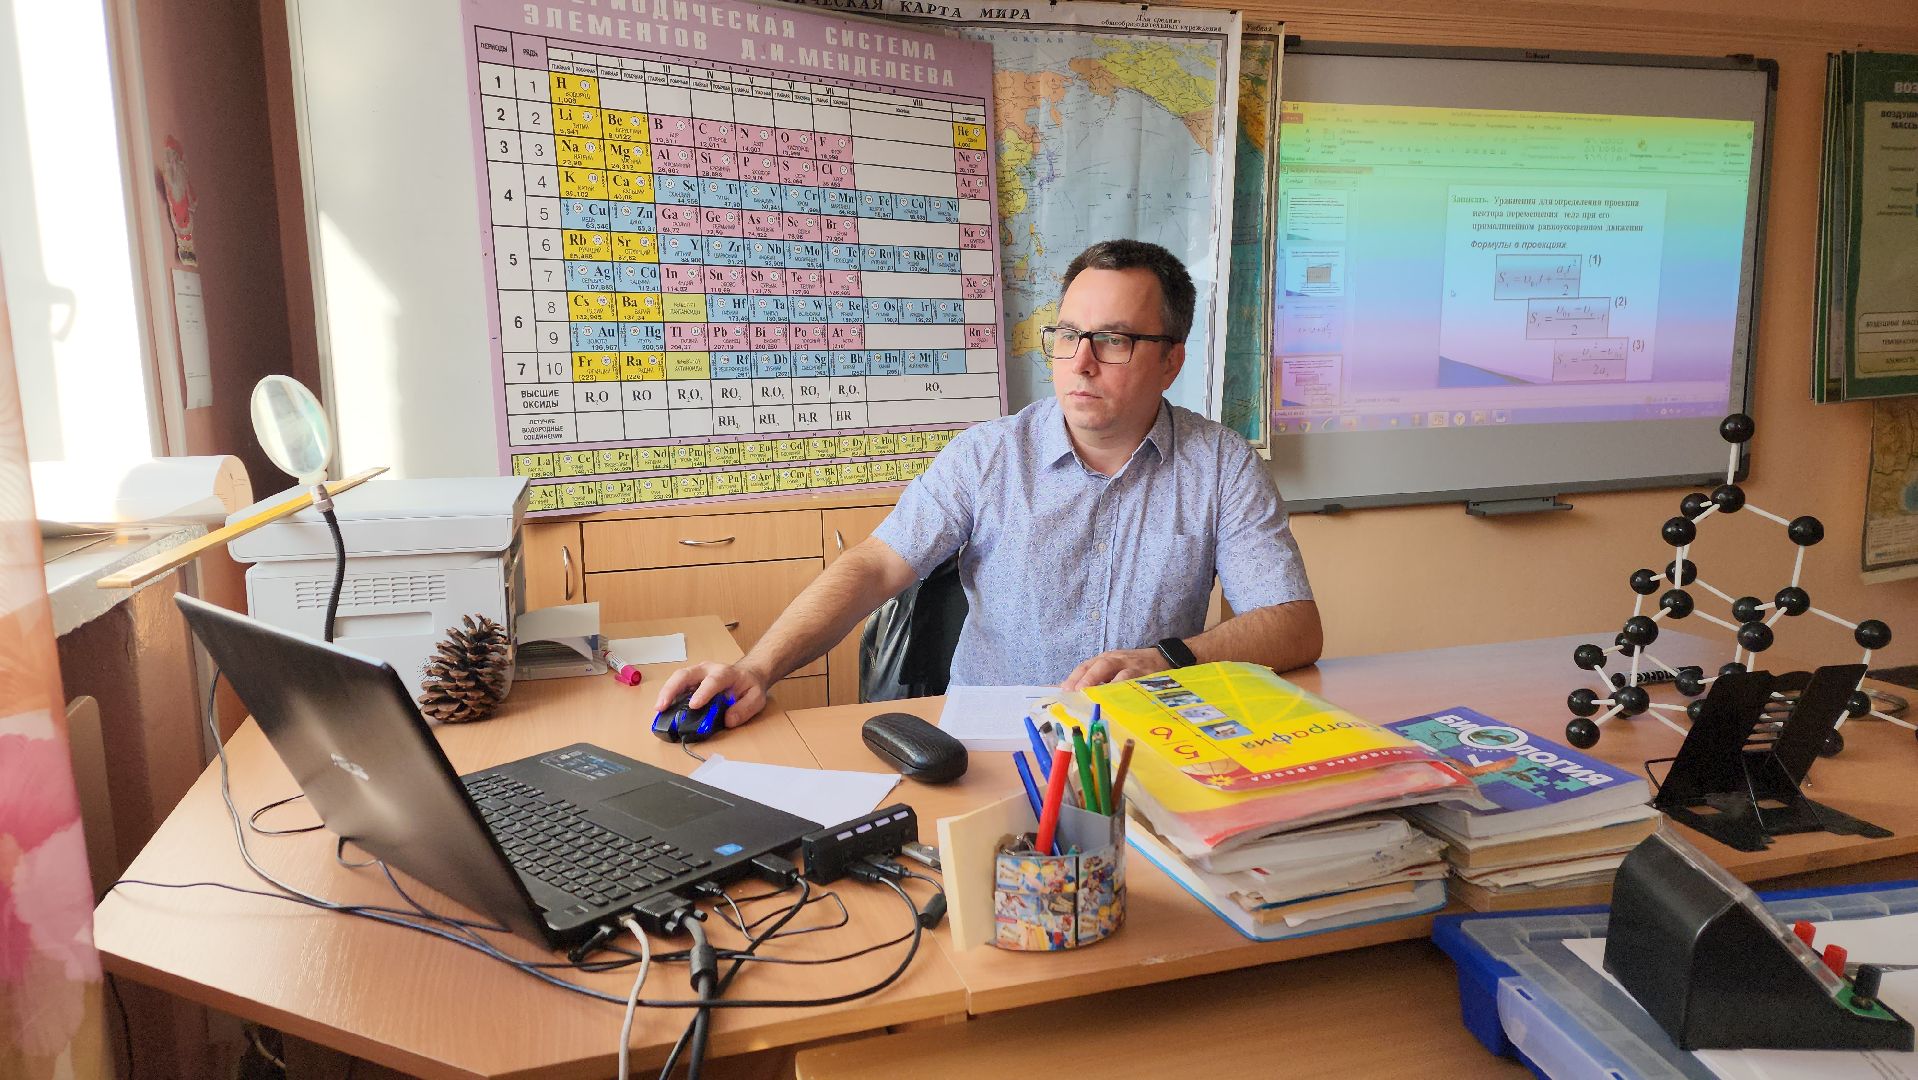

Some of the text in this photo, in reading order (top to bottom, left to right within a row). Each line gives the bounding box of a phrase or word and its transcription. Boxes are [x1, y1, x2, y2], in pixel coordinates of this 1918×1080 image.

[900, 1, 962, 18] КАРТА
[979, 8, 1031, 20] МИРА
[523, 4, 708, 50] ЭЛЕМЕНТОВ
[825, 26, 936, 60] СИСТЕМА
[494, 75, 501, 89] 1
[530, 80, 537, 94] 1
[556, 77, 567, 89] H
[497, 107, 505, 122] 2
[531, 111, 541, 126] 2
[559, 109, 573, 121] Li
[607, 113, 622, 125] Be
[654, 118, 663, 130] B
[699, 123, 708, 134] C
[740, 127, 749, 139] N
[781, 132, 790, 143] O
[499, 140, 509, 155] 3
[534, 143, 544, 157] 3
[562, 140, 579, 152] Na
[610, 144, 630, 161] Mg
[657, 149, 670, 160] Al
[701, 152, 711, 164] Si
[958, 152, 971, 162] Ne
[743, 156, 750, 167] P
[783, 161, 789, 171] S
[822, 163, 832, 175] Cl
[537, 176, 546, 189] 4
[565, 171, 574, 183] K
[613, 175, 629, 186] Ca
[961, 177, 972, 187] Ar
[503, 188, 513, 202] 4
[727, 183, 738, 195] Ti
[770, 186, 778, 196] V
[805, 189, 817, 200] Cr
[539, 208, 549, 221] 5
[589, 204, 606, 215] Cu
[637, 207, 653, 218] Zn
[662, 208, 678, 219] Ga
[706, 211, 721, 222] Ge
[748, 216, 761, 225] As
[826, 219, 836, 230] Br
[541, 239, 551, 252] 6
[569, 235, 586, 246] Rb
[617, 237, 630, 247] Sr
[690, 239, 699, 249] Y
[728, 241, 741, 252] Zr
[1470, 240, 1511, 250] Формулы
[1521, 242, 1567, 250] проекциях
[509, 253, 517, 266] 5
[1588, 253, 1601, 265] (1)
[543, 270, 553, 283] 7
[594, 267, 610, 280] Ag
[640, 266, 657, 278] Cd
[666, 268, 677, 279] In
[709, 269, 723, 280] Sn
[574, 295, 589, 307] Cs
[622, 297, 637, 308] Ba
[813, 300, 823, 309] W
[1614, 297, 1627, 308] (2)
[547, 301, 556, 314] 8
[514, 315, 523, 329] 6
[599, 326, 614, 337] Au
[645, 325, 662, 339] Hg
[670, 327, 682, 337] Tl
[713, 326, 728, 337] Pb
[755, 327, 766, 338] Bi
[832, 327, 843, 338] At
[969, 327, 981, 337] Rn
[549, 332, 559, 345] 9
[1632, 340, 1645, 351] (3)
[578, 356, 592, 367] Fr
[626, 355, 642, 366] Ra
[517, 362, 526, 376] 7
[546, 363, 562, 375] 10
[520, 389, 560, 399] ВЫСШИЕ
[632, 389, 652, 401] RO
[522, 400, 559, 410] ОКСИДЫ
[836, 410, 852, 422] HR
[653, 449, 667, 458] Nd
[1149, 726, 1173, 740] 6
[1173, 744, 1199, 760] 5
[1434, 714, 1614, 787] БИОЛОГИЯ
[1467, 752, 1494, 768] 7
